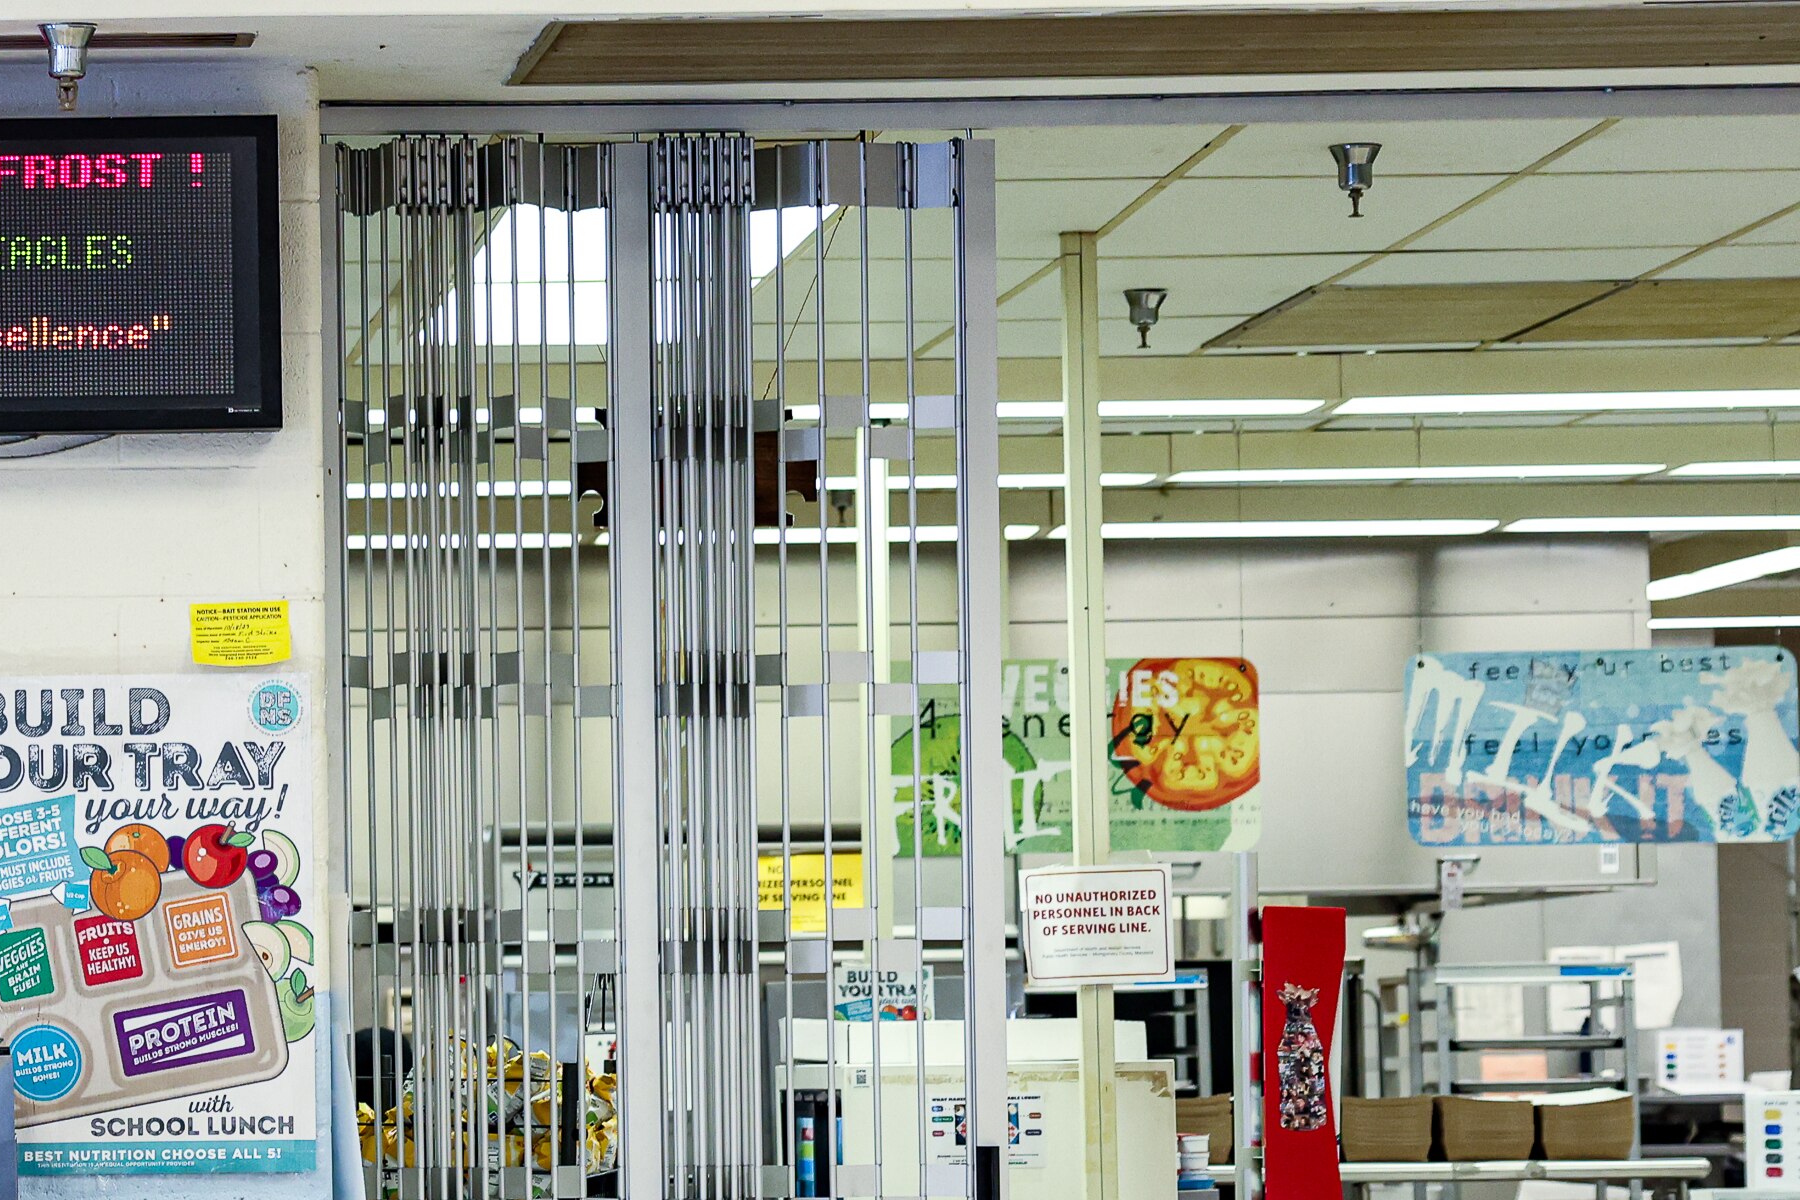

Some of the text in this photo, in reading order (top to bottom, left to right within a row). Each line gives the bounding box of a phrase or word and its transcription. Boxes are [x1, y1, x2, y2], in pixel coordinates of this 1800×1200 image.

[190, 152, 204, 187] !
[1660, 652, 1731, 674] best
[259, 691, 291, 708] DF
[259, 707, 292, 726] NS
[920, 698, 936, 739] 4
[124, 740, 285, 791] TRAY
[36, 805, 60, 820] 3-5
[85, 783, 289, 834] your way!
[1410, 800, 1450, 817] have
[0, 864, 27, 879] MUST
[28, 855, 71, 874] INCLUDE
[25, 876, 38, 884] or
[39, 867, 75, 883] FRUITS
[75, 892, 86, 900] Cup
[1035, 889, 1157, 904] NO UNAUTHORIZED
[173, 906, 223, 930] GRAINS
[1033, 905, 1160, 920] PERSONNEL IN BACK
[78, 922, 134, 945] FRUITS
[178, 926, 223, 942] GIVE US
[1043, 922, 1152, 936] OF SERVING LINE.
[89, 943, 130, 961] KEEP US
[179, 937, 227, 954] ENERGY!
[15, 961, 29, 972] ARE
[87, 954, 137, 976] HEALTHY!
[7, 963, 41, 987] BRAIN
[12, 976, 41, 996] FUEL!
[129, 1001, 236, 1056] PROTEIN
[133, 1022, 239, 1066] BUILDS STRONG MUSCLES!
[16, 1042, 68, 1067] MILK
[15, 1060, 74, 1077] BUILDS STRONG
[189, 1095, 233, 1113] with
[91, 1116, 295, 1137] SCHOOL LUNCH
[24, 1148, 282, 1162] BEST NUTRITION CHOOSE ALL 5!
